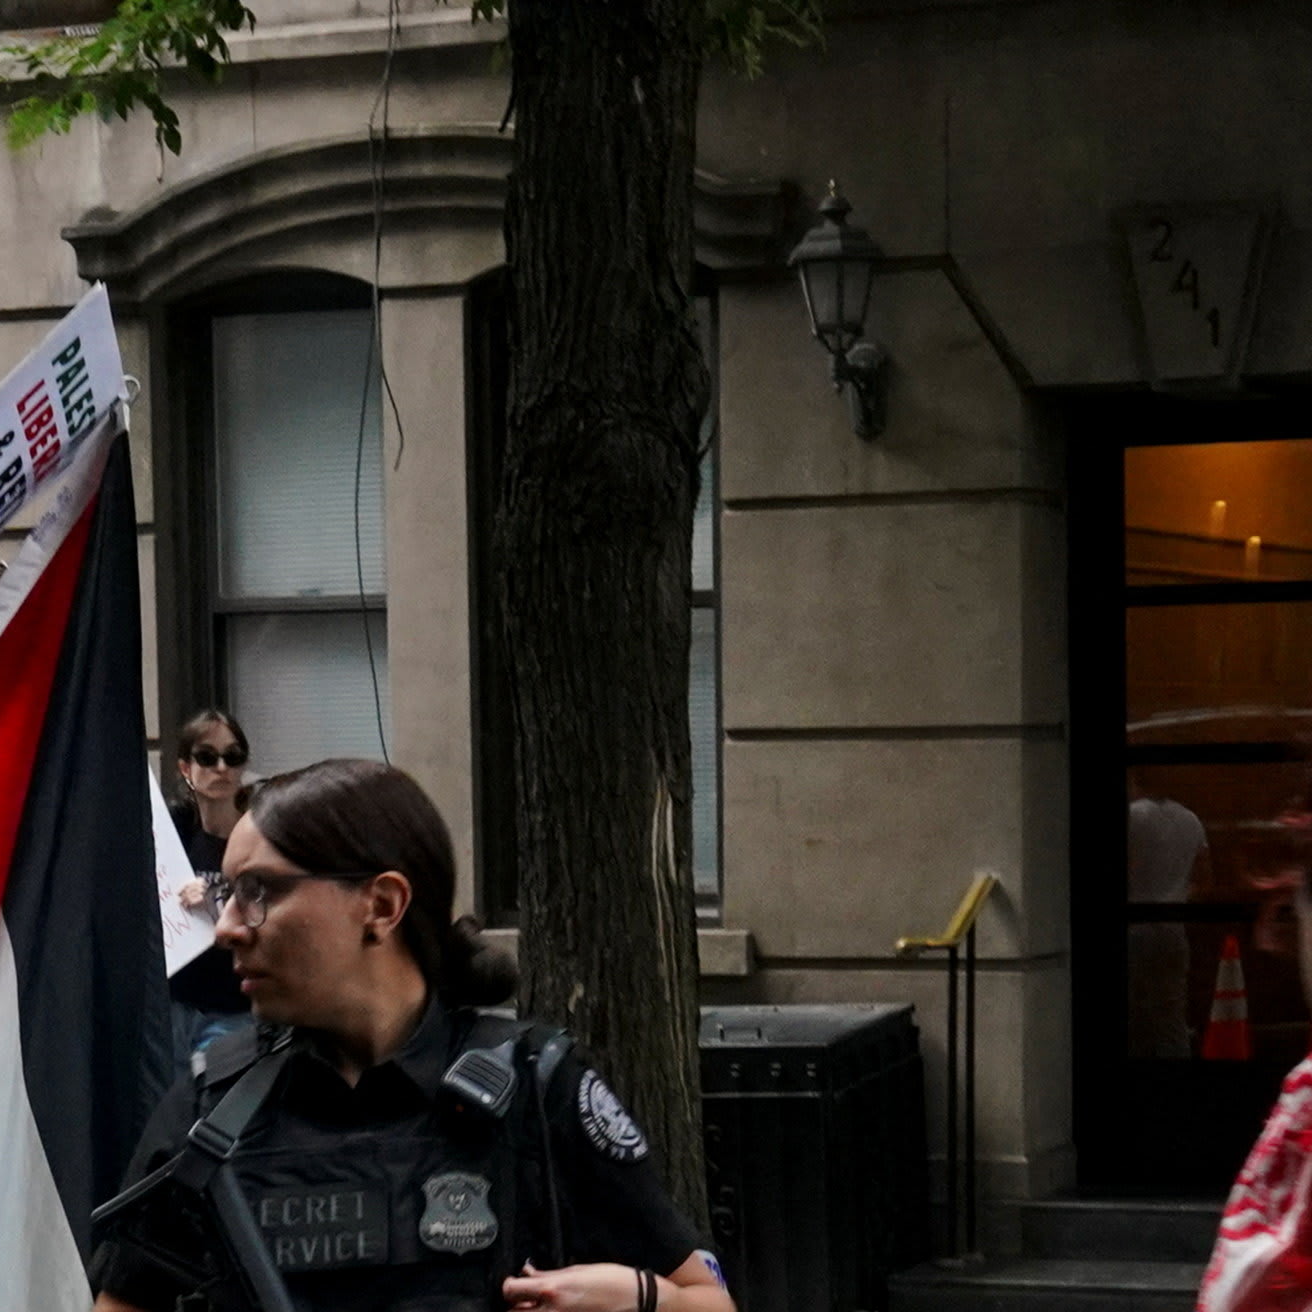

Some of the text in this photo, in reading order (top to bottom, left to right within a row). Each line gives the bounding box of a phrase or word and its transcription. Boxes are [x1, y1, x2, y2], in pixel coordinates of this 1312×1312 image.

[52, 336, 98, 438] PALES
[259, 1191, 368, 1228] ECRET
[274, 1230, 377, 1266] RVICE
